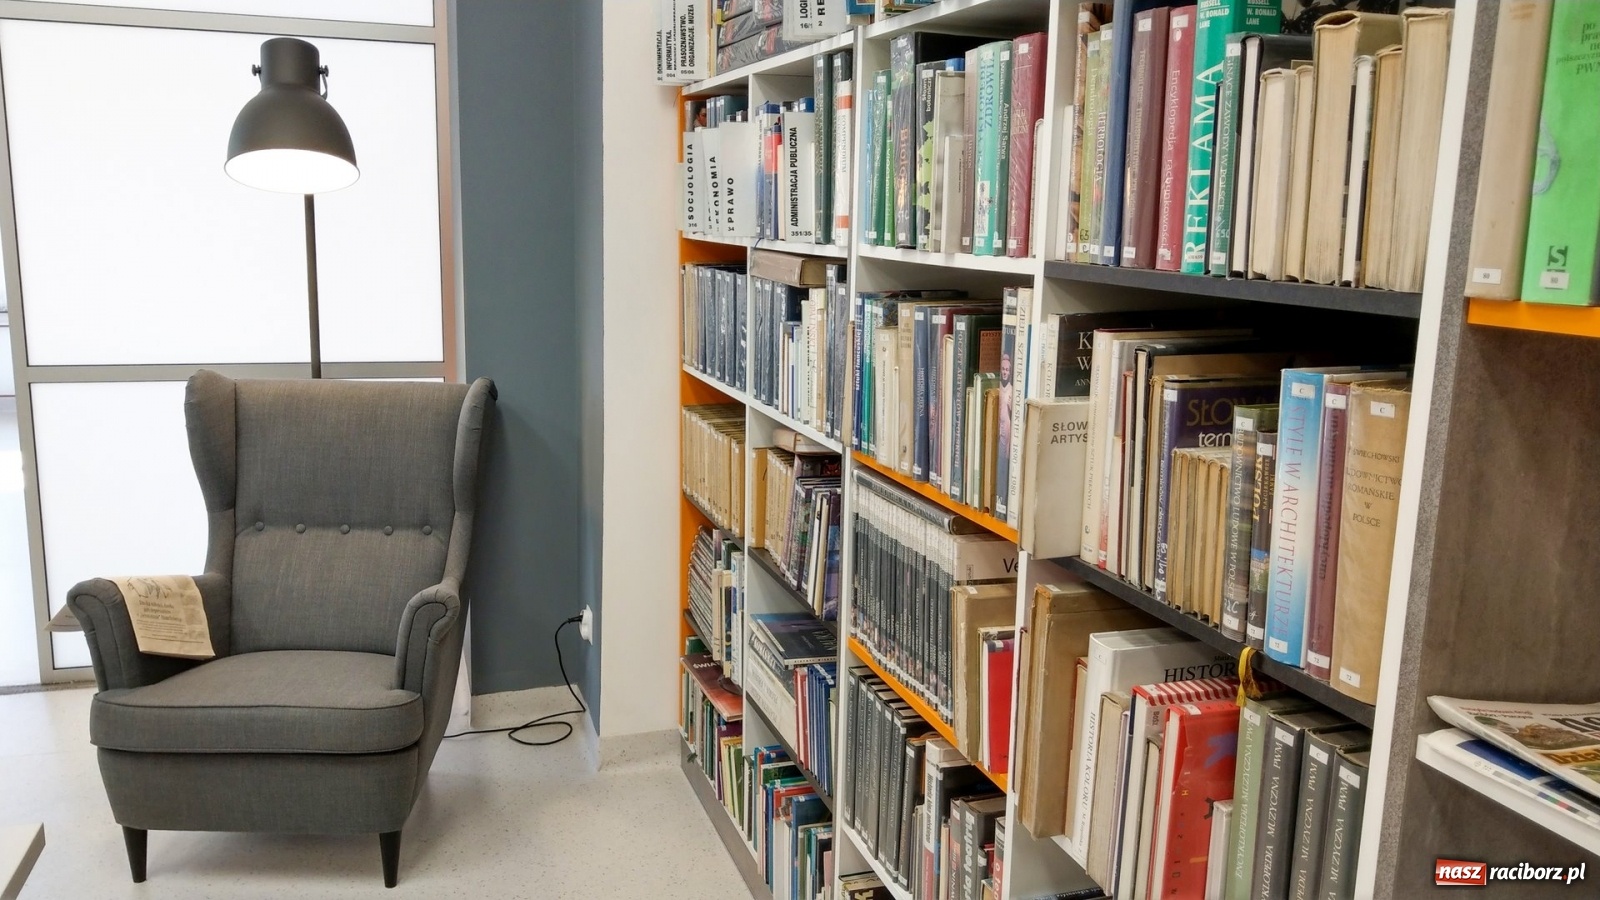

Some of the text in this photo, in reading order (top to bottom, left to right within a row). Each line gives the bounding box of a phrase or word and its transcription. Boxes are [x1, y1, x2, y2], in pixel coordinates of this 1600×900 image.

[1206, 8, 1230, 18] RONALD
[1254, 8, 1277, 16] RONALD
[1088, 68, 1098, 136] Dendrologia
[1168, 70, 1181, 152] Encyklopedia
[1221, 100, 1232, 152] ZAWODY
[1096, 112, 1106, 182] HERBOLOGIA
[1185, 60, 1225, 259] REKLAMA
[789, 127, 799, 227] ADMINISTRACJA PUBLICZNA
[1016, 342, 1024, 384] SZTUKI
[1013, 390, 1022, 439] POLSKIEJ
[1230, 507, 1241, 550] LUDOWE
[1272, 406, 1306, 636] STYLE W ARCHITEKTURZE
[1352, 513, 1381, 528] POLSCE
[1227, 564, 1236, 598] POLSCE
[1164, 662, 1236, 682] HISTOR
[1086, 712, 1096, 762] HISTORIA
[1273, 741, 1283, 770] PWM
[1082, 765, 1092, 810] KOLORU
[1235, 803, 1248, 879] ENCYKLOPEDIA
[1243, 744, 1253, 801] MUZYCZNA
[1267, 776, 1280, 838] MUZYCZNA
[1301, 798, 1314, 861] MUZYCZNA
[1308, 762, 1318, 791] PWM
[1332, 780, 1349, 884] MUZYCZNA PWM
